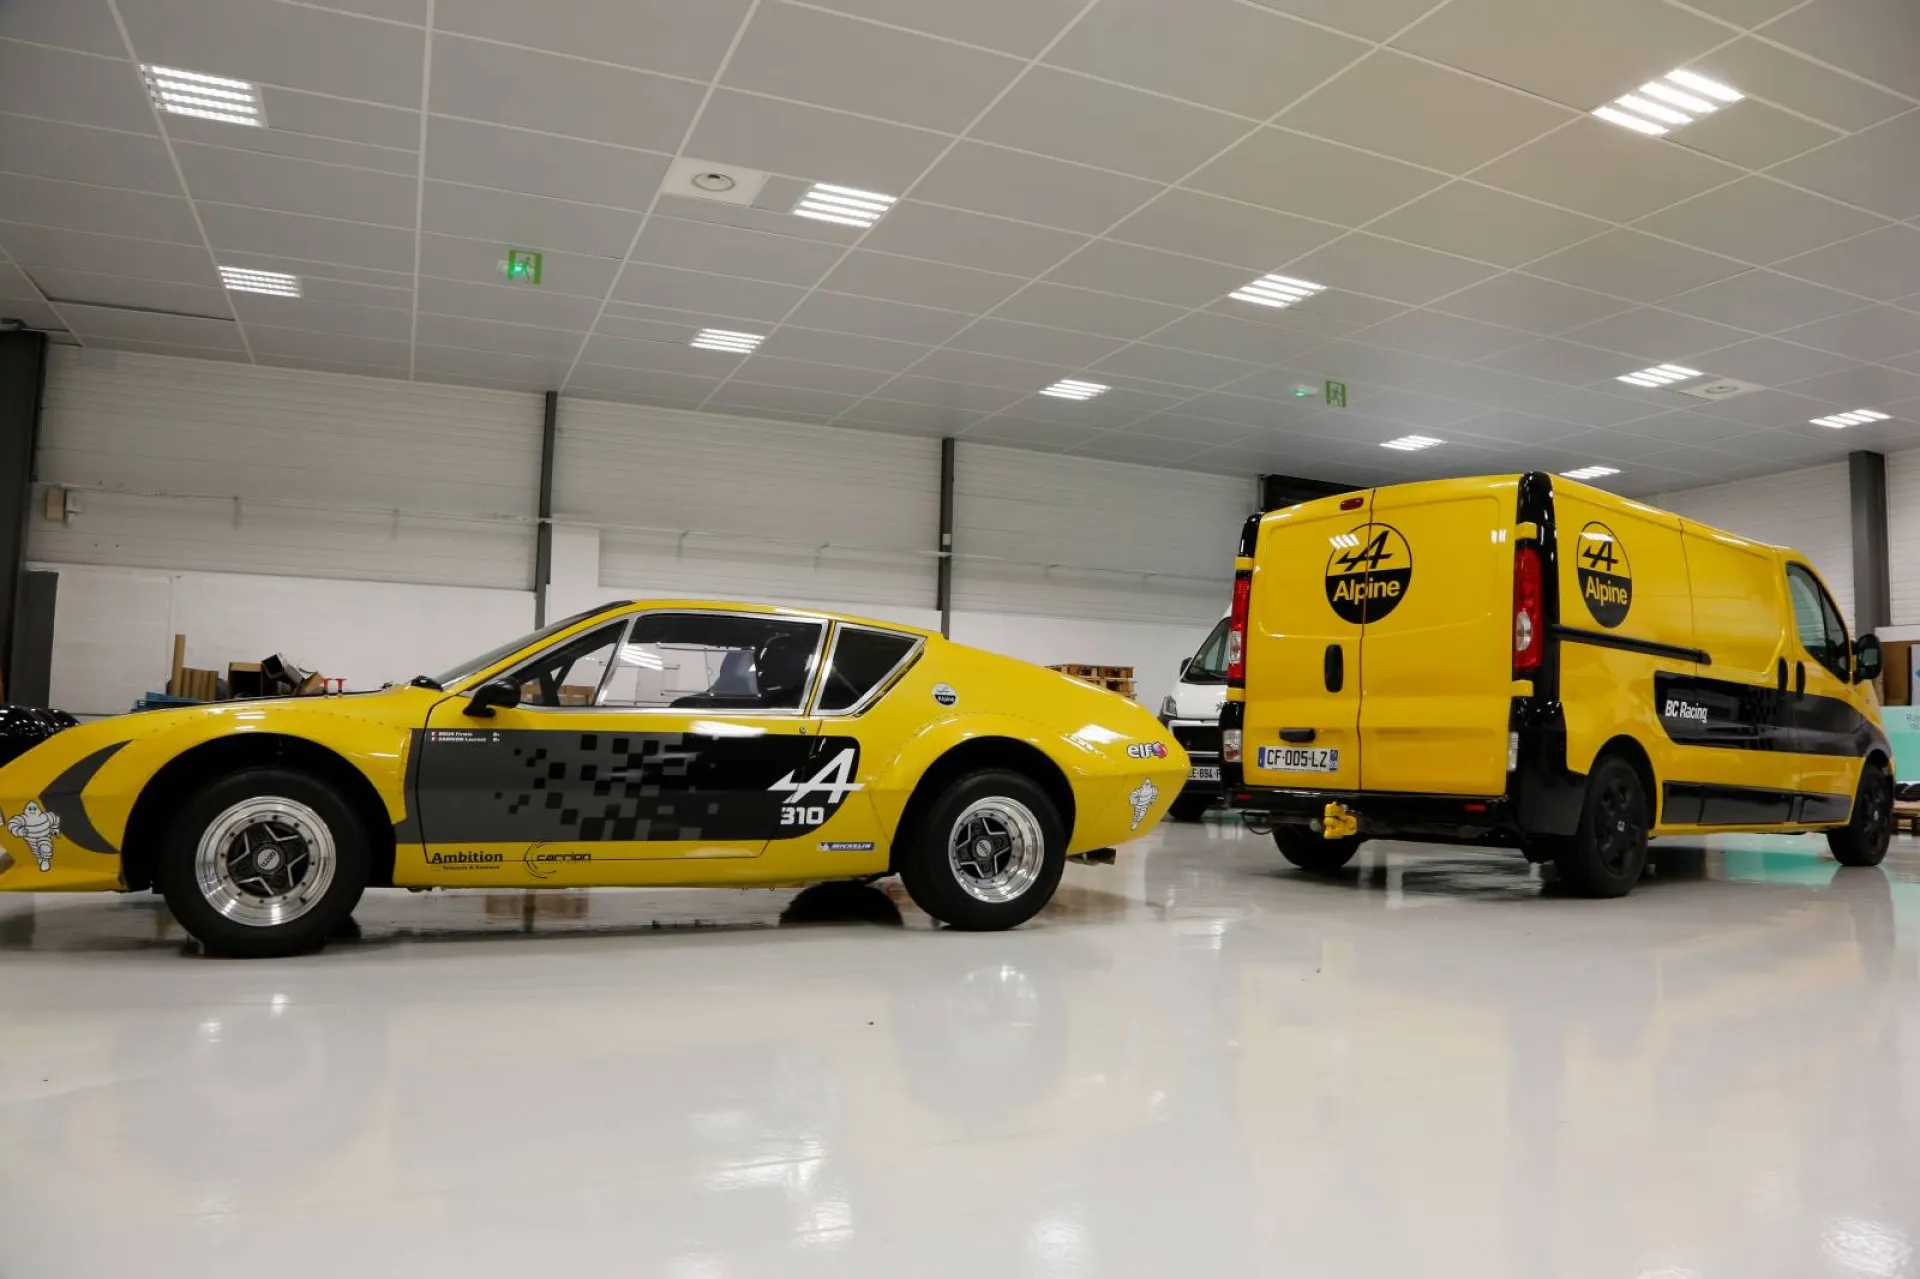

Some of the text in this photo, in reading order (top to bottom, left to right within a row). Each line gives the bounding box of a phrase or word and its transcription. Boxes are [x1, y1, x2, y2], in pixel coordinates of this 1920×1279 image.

[1333, 577, 1400, 605] Alpine
[1585, 576, 1628, 606] Alpine
[1665, 700, 1708, 723] BC Racing
[1127, 743, 1153, 758] elf
[1267, 749, 1328, 768] CF-005-LZ
[780, 807, 824, 825] 310
[432, 851, 503, 864] Ambition
